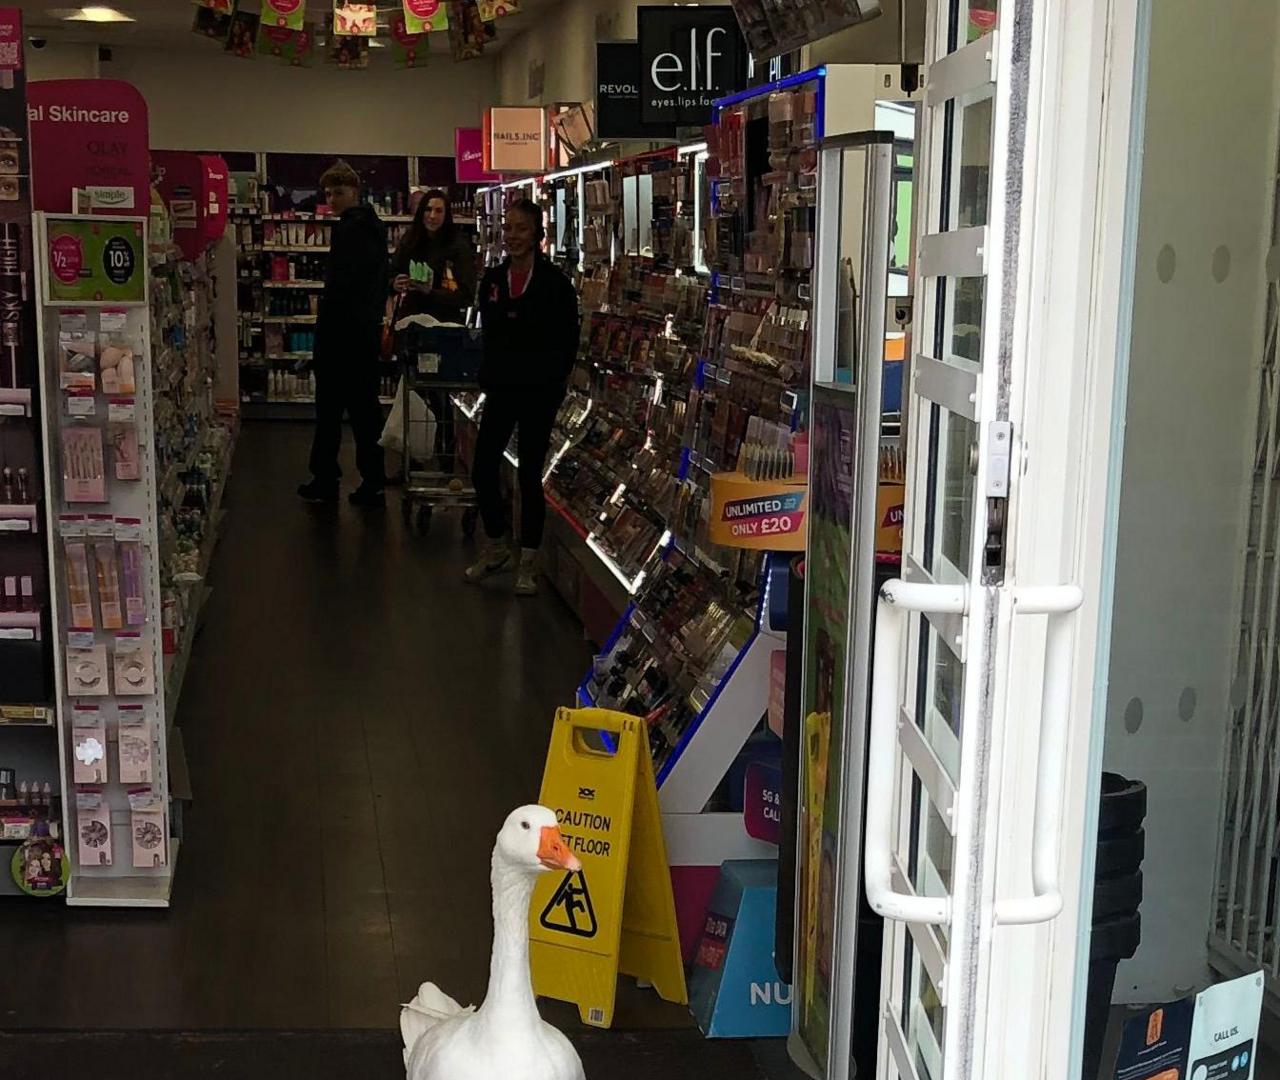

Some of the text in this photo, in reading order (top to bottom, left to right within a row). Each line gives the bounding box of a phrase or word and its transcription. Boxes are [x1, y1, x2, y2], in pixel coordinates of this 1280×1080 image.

[49, 105, 129, 123] Skincare
[0, 238, 19, 276] HIGH
[1, 290, 20, 321] SKY
[725, 502, 782, 518] UNLIMITED
[732, 516, 791, 536] ONLY £20
[555, 808, 611, 831] CAUTION
[574, 836, 610, 856] FLOOR
[750, 982, 792, 1005] NU
[1213, 1030, 1229, 1042] CALL
